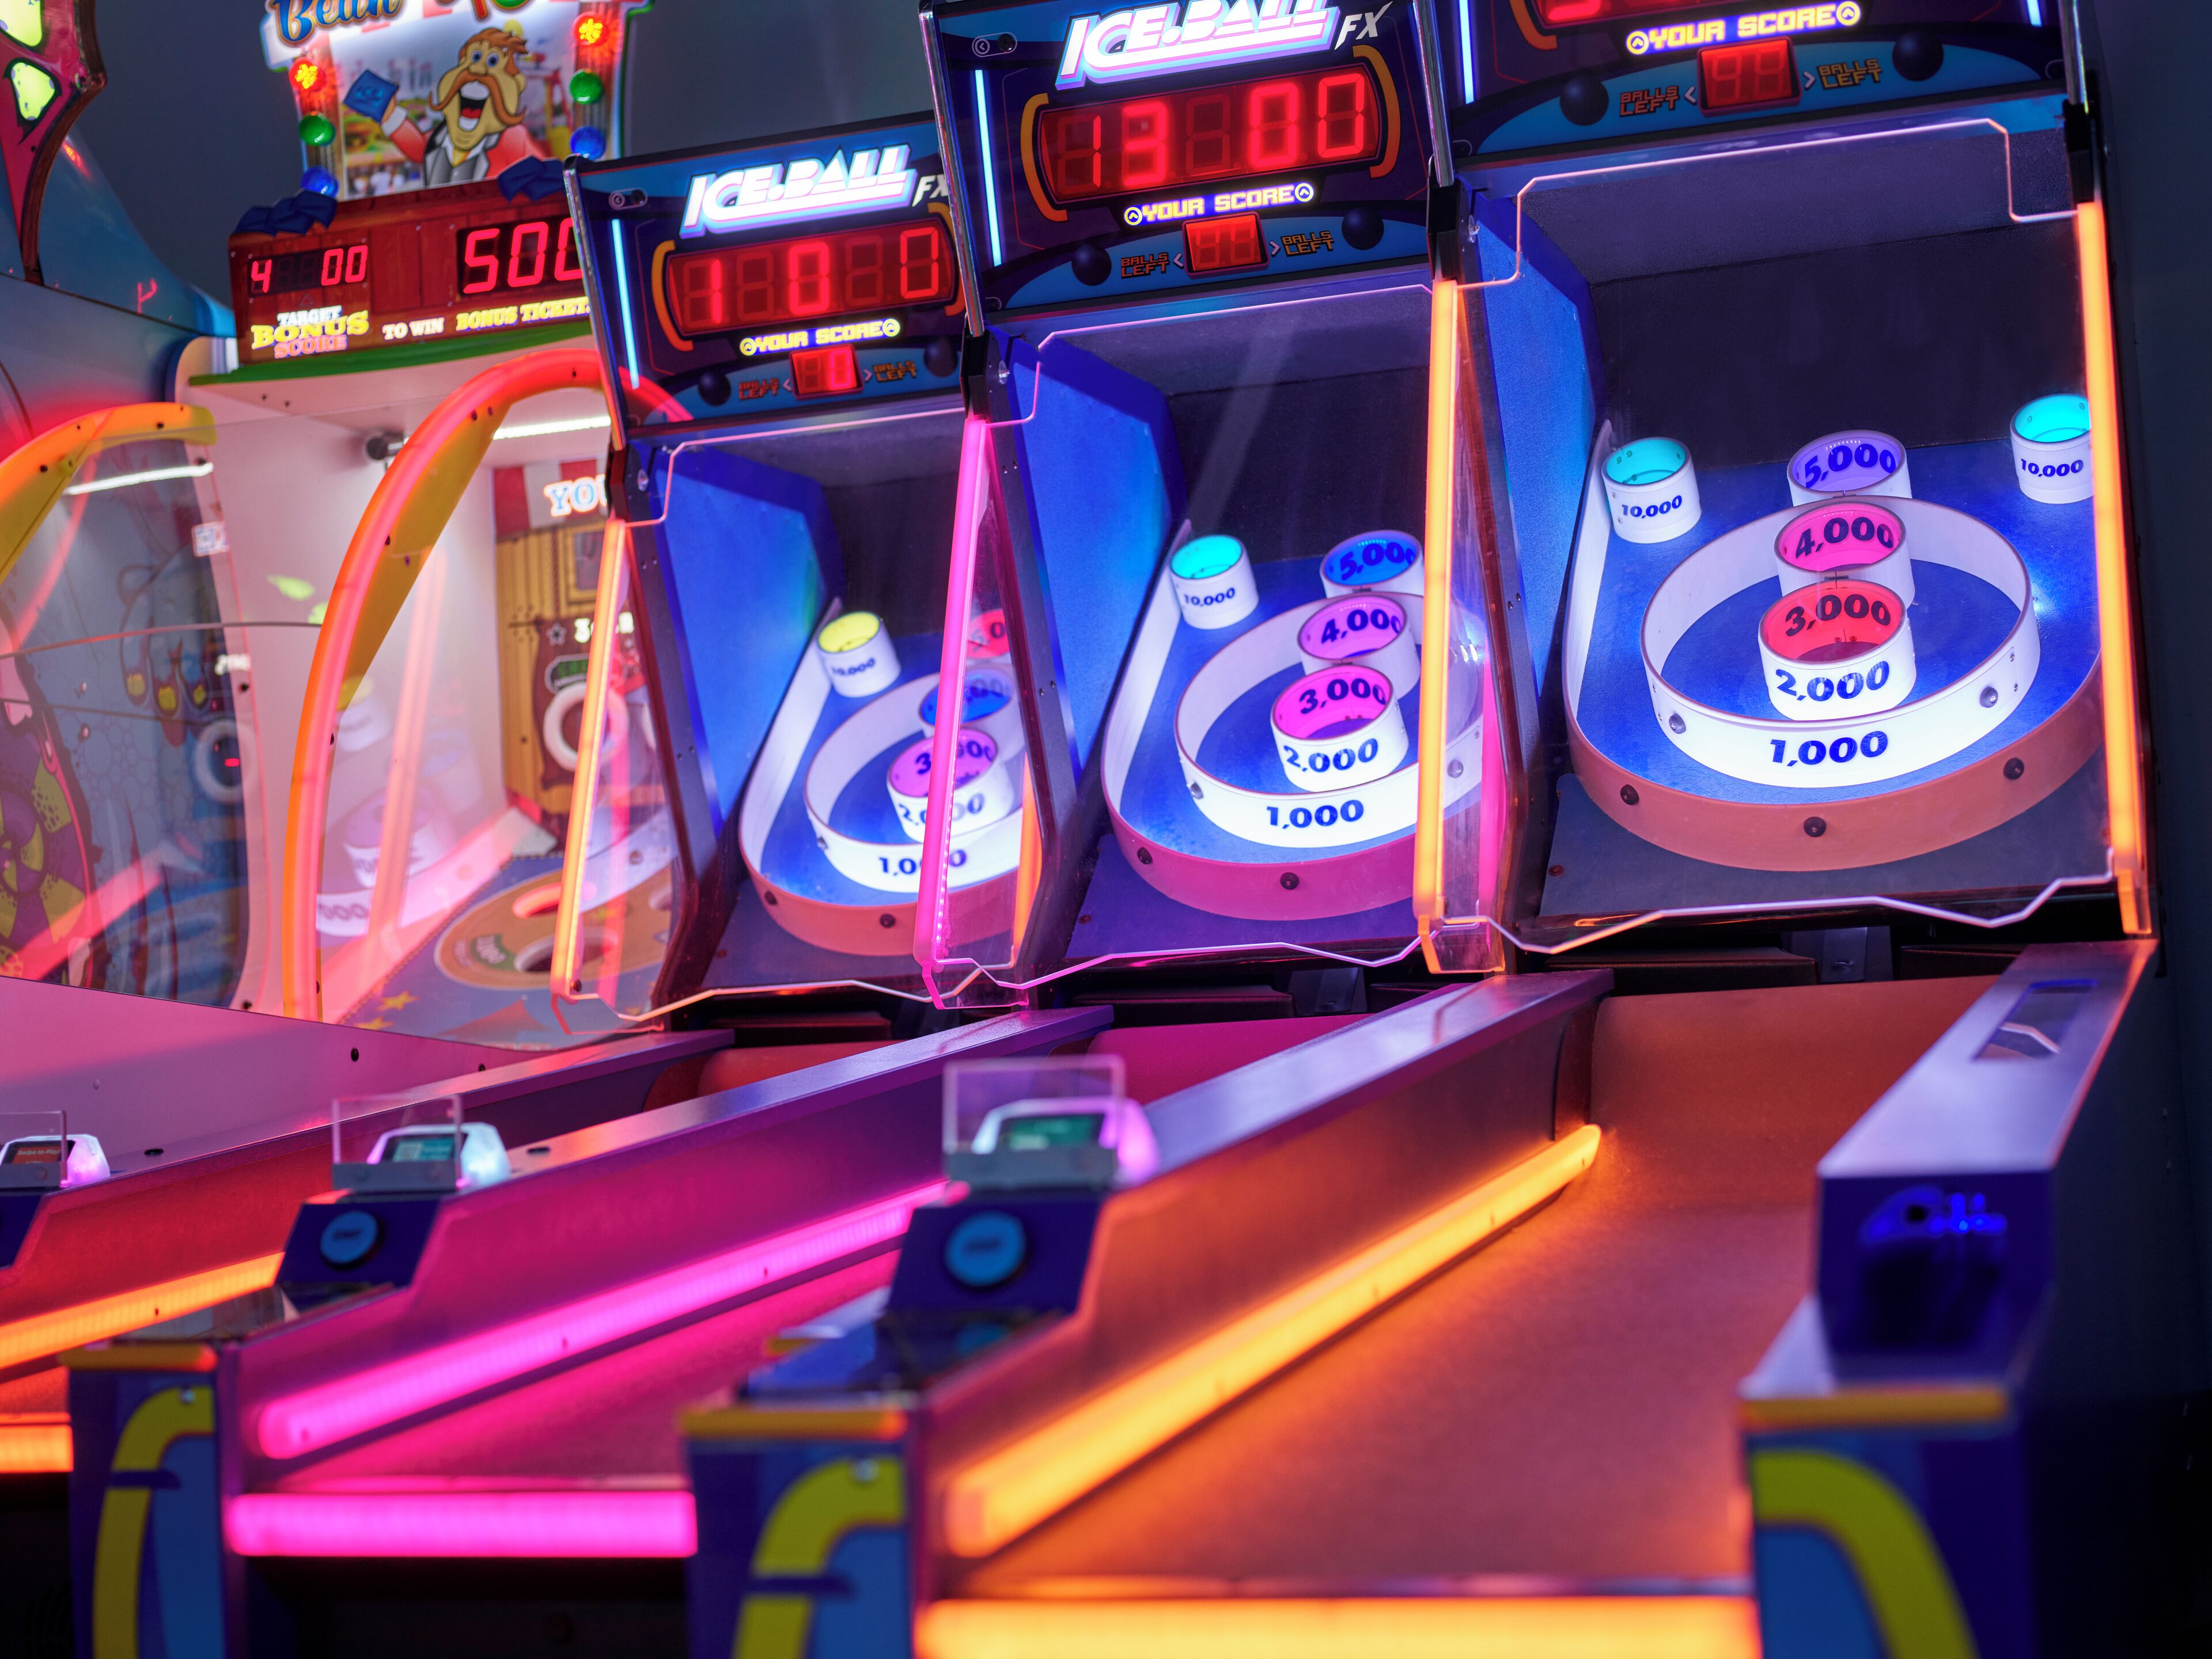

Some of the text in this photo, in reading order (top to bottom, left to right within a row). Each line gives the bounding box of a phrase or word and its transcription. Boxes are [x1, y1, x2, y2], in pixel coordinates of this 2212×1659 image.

[1335, 2, 1392, 50] FX
[1650, 5, 1836, 49] YOUR SCORE
[1818, 59, 1880, 77] BALLS
[1821, 69, 1882, 89] LEFT
[1620, 85, 1679, 103] BALLS
[1620, 96, 1679, 116] LEFT
[1143, 186, 1295, 224] YOUR SCORE
[1282, 230, 1332, 245] BALLS
[1285, 239, 1334, 256] LEFT
[1120, 252, 1169, 267] BALLS
[1121, 262, 1169, 278] LEFT
[251, 310, 369, 350] BONUS
[277, 305, 342, 326] TARGET
[382, 296, 590, 340] TO WIN BONUS TICKET
[274, 334, 347, 359] SCORE
[755, 321, 884, 352] YOUR SCORE
[876, 368, 918, 382] LEFT
[739, 385, 778, 400] LEFT
[1805, 442, 1896, 489] 5,000
[2020, 457, 2084, 478] 10,000
[1620, 494, 1683, 520] 10,000
[1795, 516, 1895, 559] 4,000
[1340, 542, 1416, 581] 5,000
[1184, 587, 1236, 607] 10,000
[1321, 609, 1402, 644] 4,000
[1785, 593, 1891, 637] 3,000
[1298, 677, 1388, 715] 3,000
[1775, 660, 1890, 702] 2,000
[1283, 737, 1378, 773] 2,000
[1769, 729, 1889, 768] 1,000
[1266, 799, 1365, 830] 1,000
